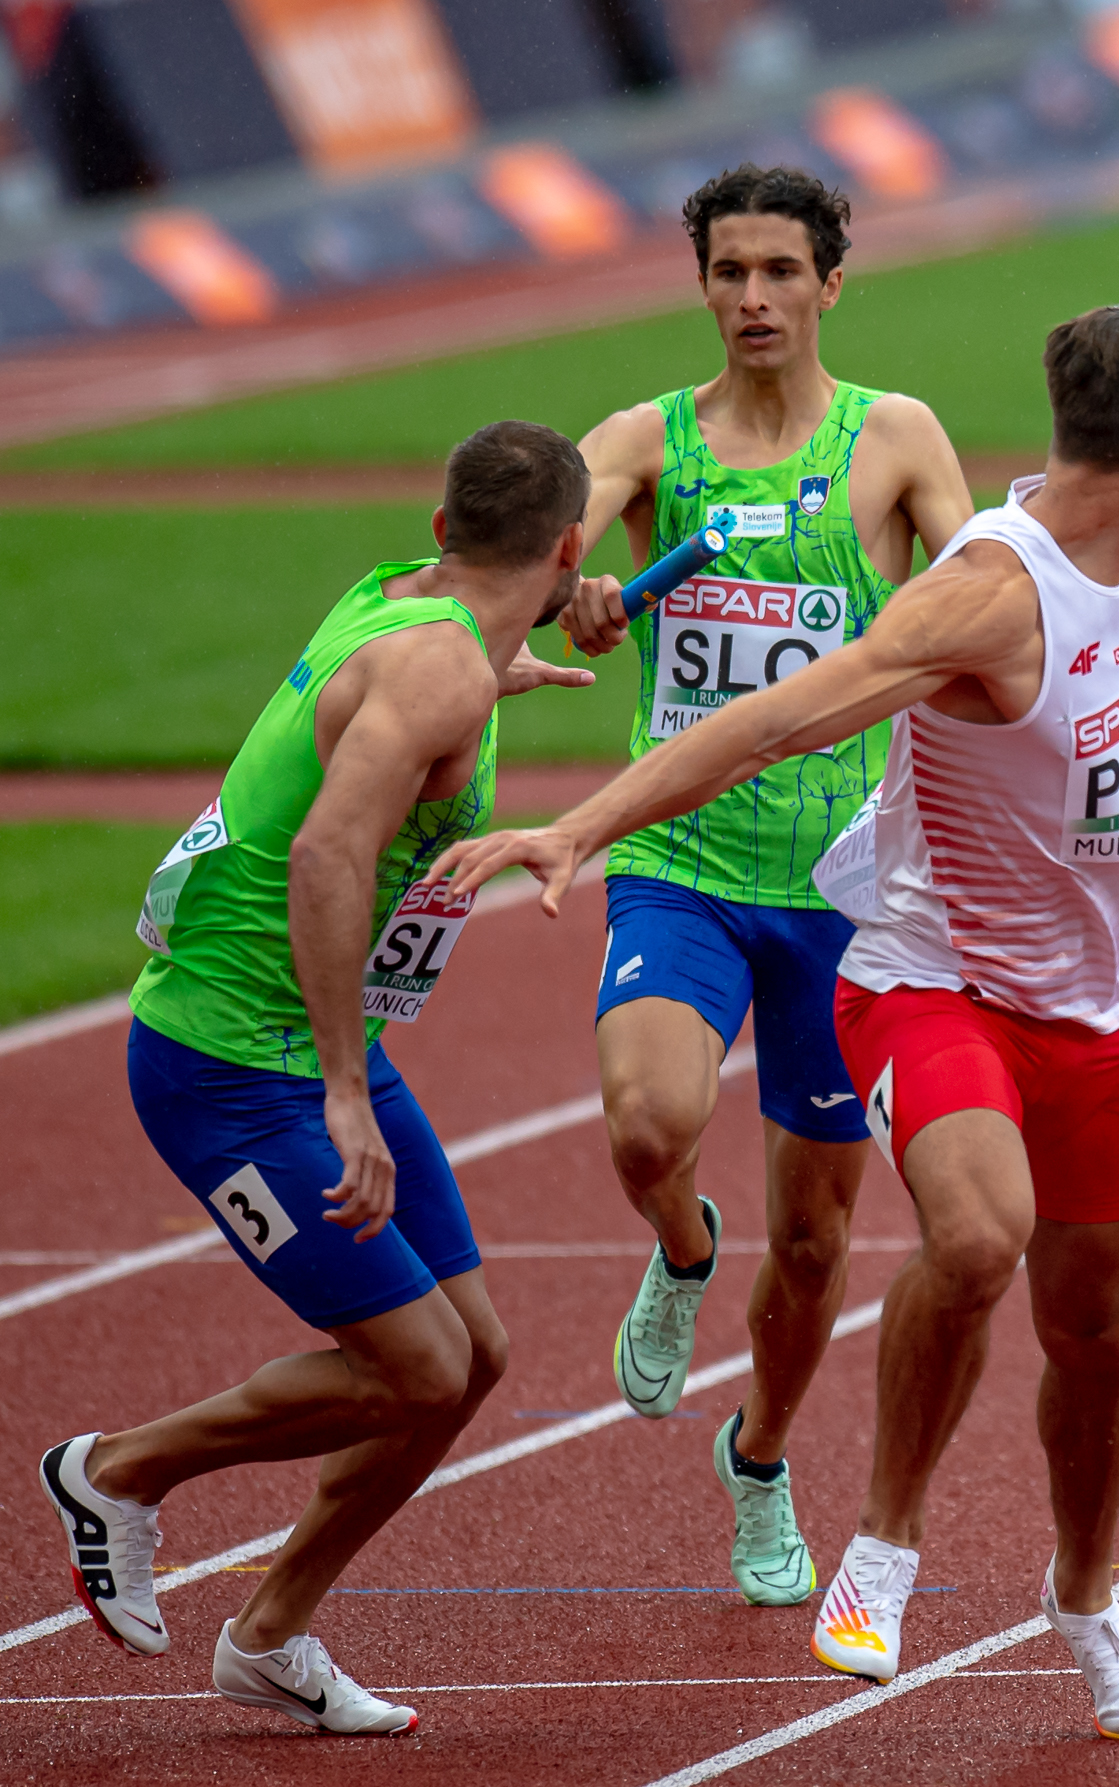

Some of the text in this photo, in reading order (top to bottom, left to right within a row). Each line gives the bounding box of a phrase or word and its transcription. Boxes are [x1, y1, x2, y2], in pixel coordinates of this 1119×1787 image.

[742, 512, 783, 521] Telekom
[742, 521, 783, 532] Slovenije
[669, 583, 792, 622] SPAR
[700, 691, 732, 706] RUN
[401, 884, 472, 913] SPA
[373, 922, 447, 978] SL
[390, 975, 422, 991] RUN
[227, 1191, 270, 1246] 3
